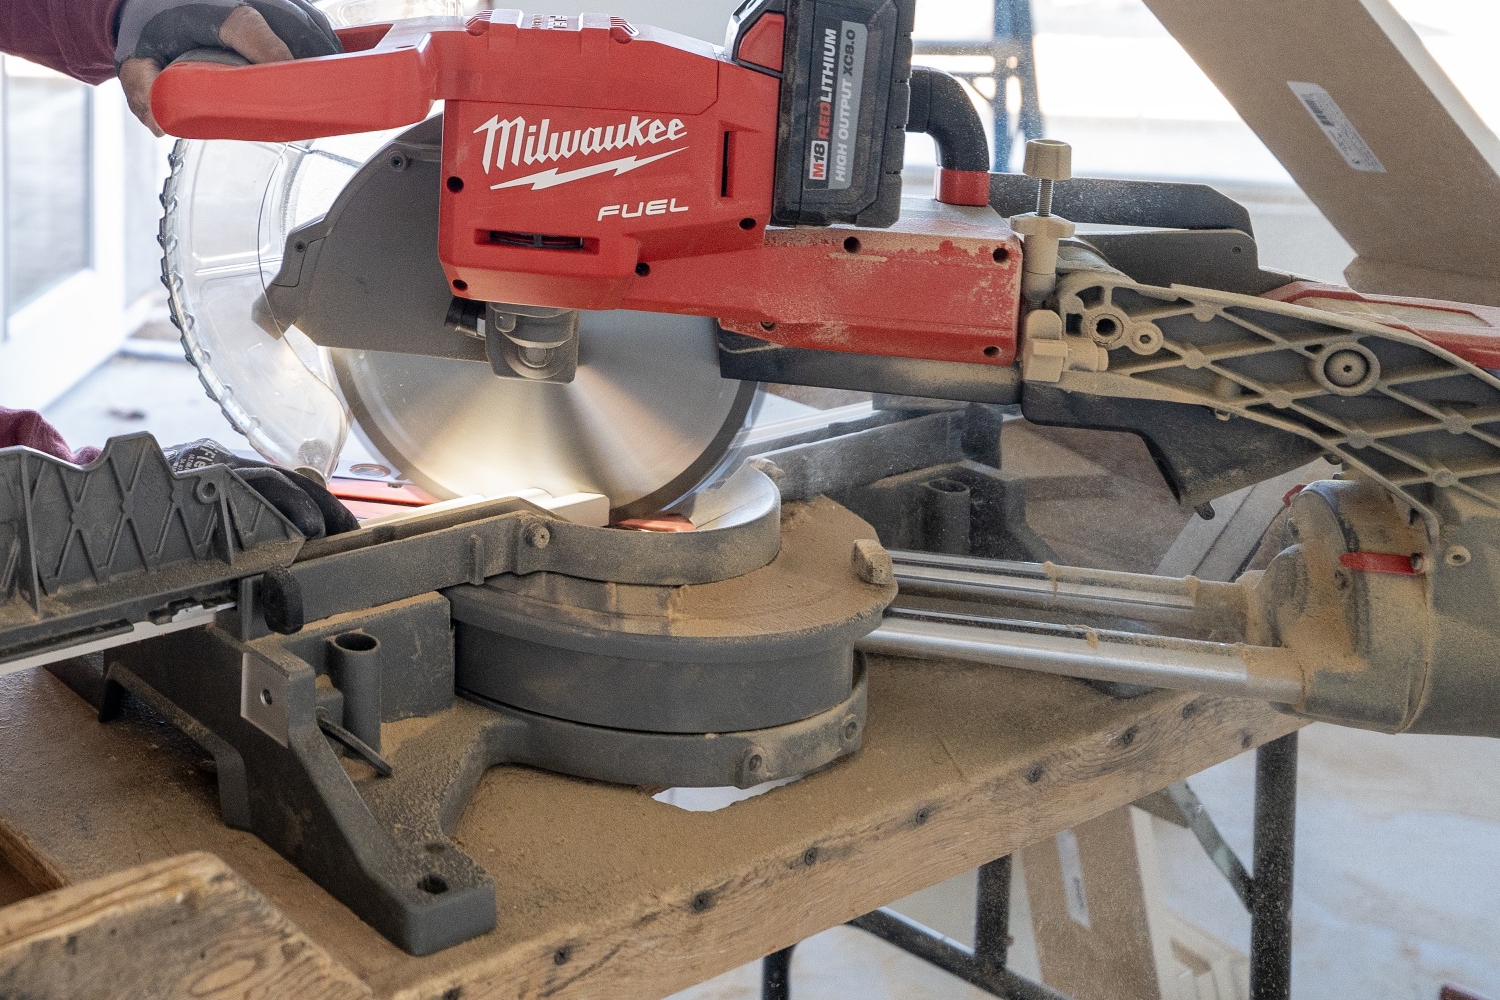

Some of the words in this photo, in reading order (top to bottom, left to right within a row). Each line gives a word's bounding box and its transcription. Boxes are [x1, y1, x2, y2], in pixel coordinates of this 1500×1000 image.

[842, 29, 856, 77] XC8.0
[838, 78, 852, 140] OUTPUT
[472, 114, 688, 175] Milwaukee
[812, 143, 825, 178] M18
[835, 144, 848, 182] HIGH
[597, 198, 689, 222] FUEL
